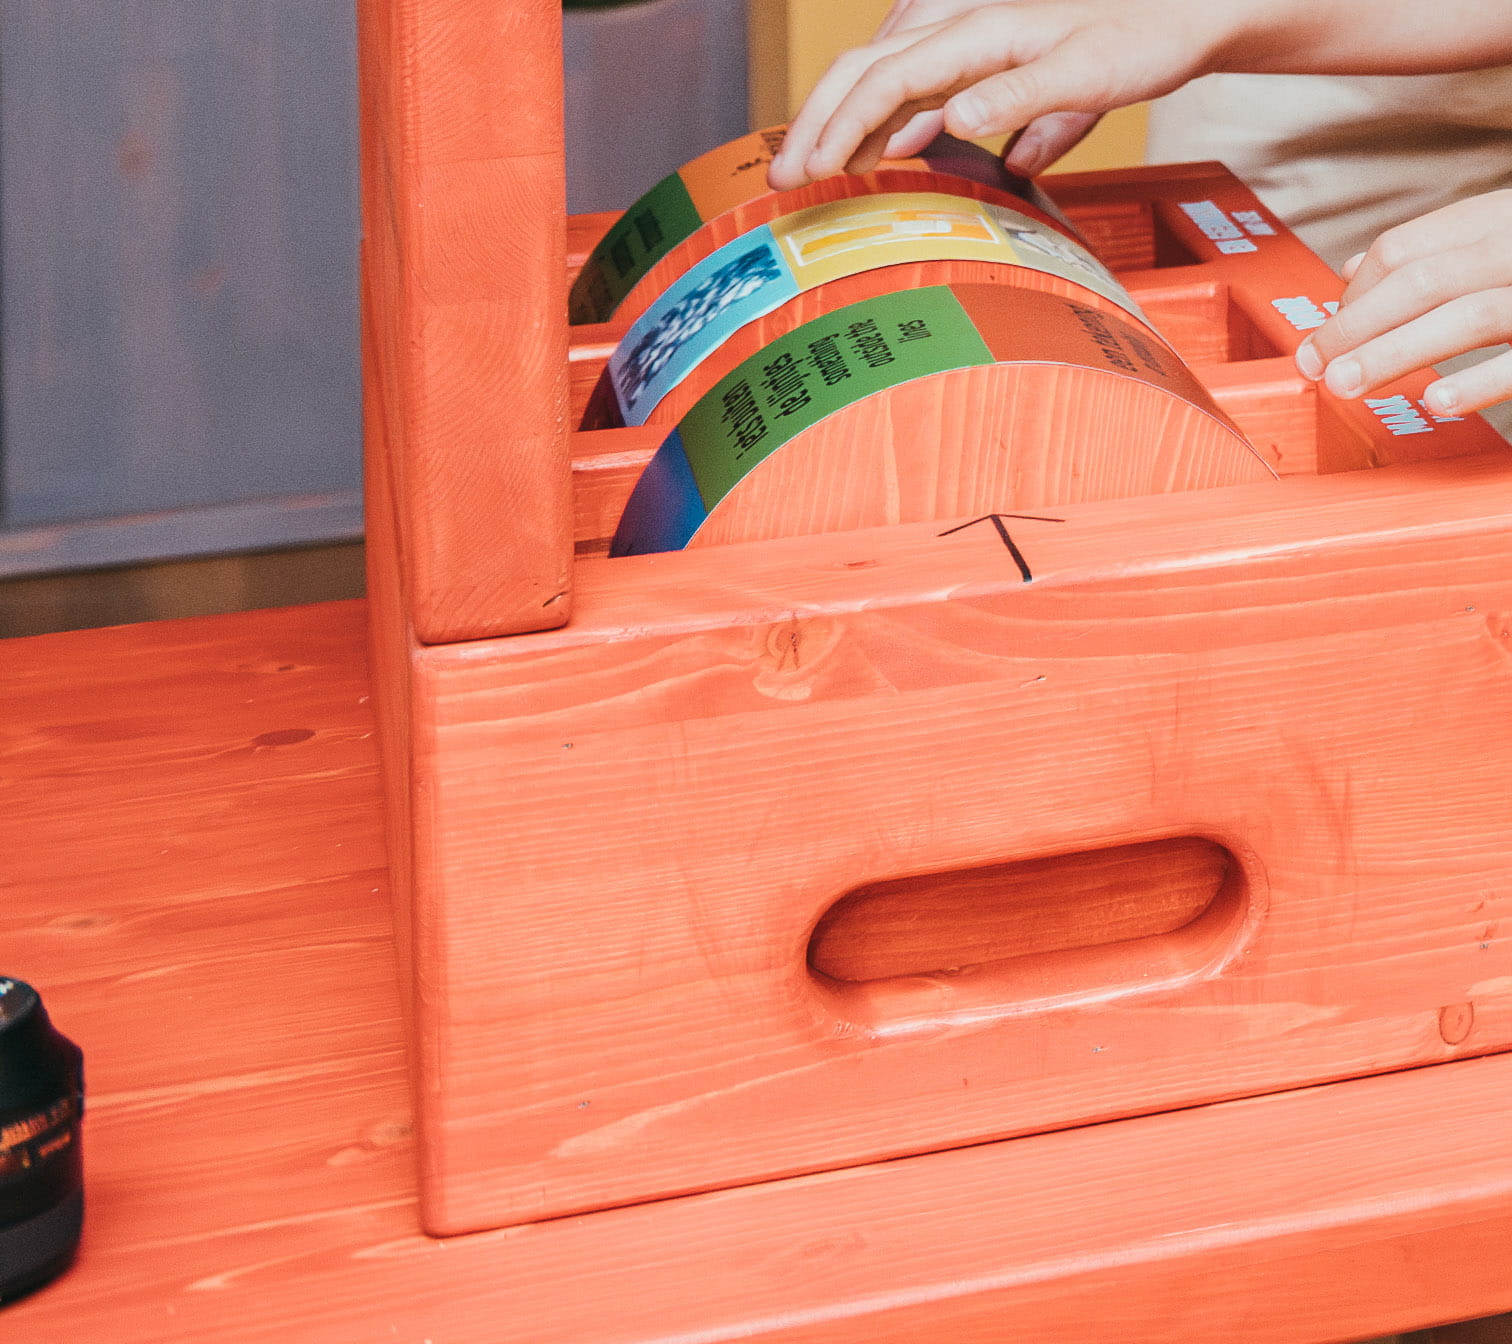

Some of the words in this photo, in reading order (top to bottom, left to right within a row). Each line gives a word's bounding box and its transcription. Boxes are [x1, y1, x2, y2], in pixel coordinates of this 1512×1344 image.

[844, 319, 882, 340] the
[897, 319, 933, 344] lines
[806, 333, 852, 387] something
[851, 335, 896, 369] outside
[760, 352, 811, 408] lijntjes
[721, 378, 760, 438] buiten
[773, 389, 812, 420] de
